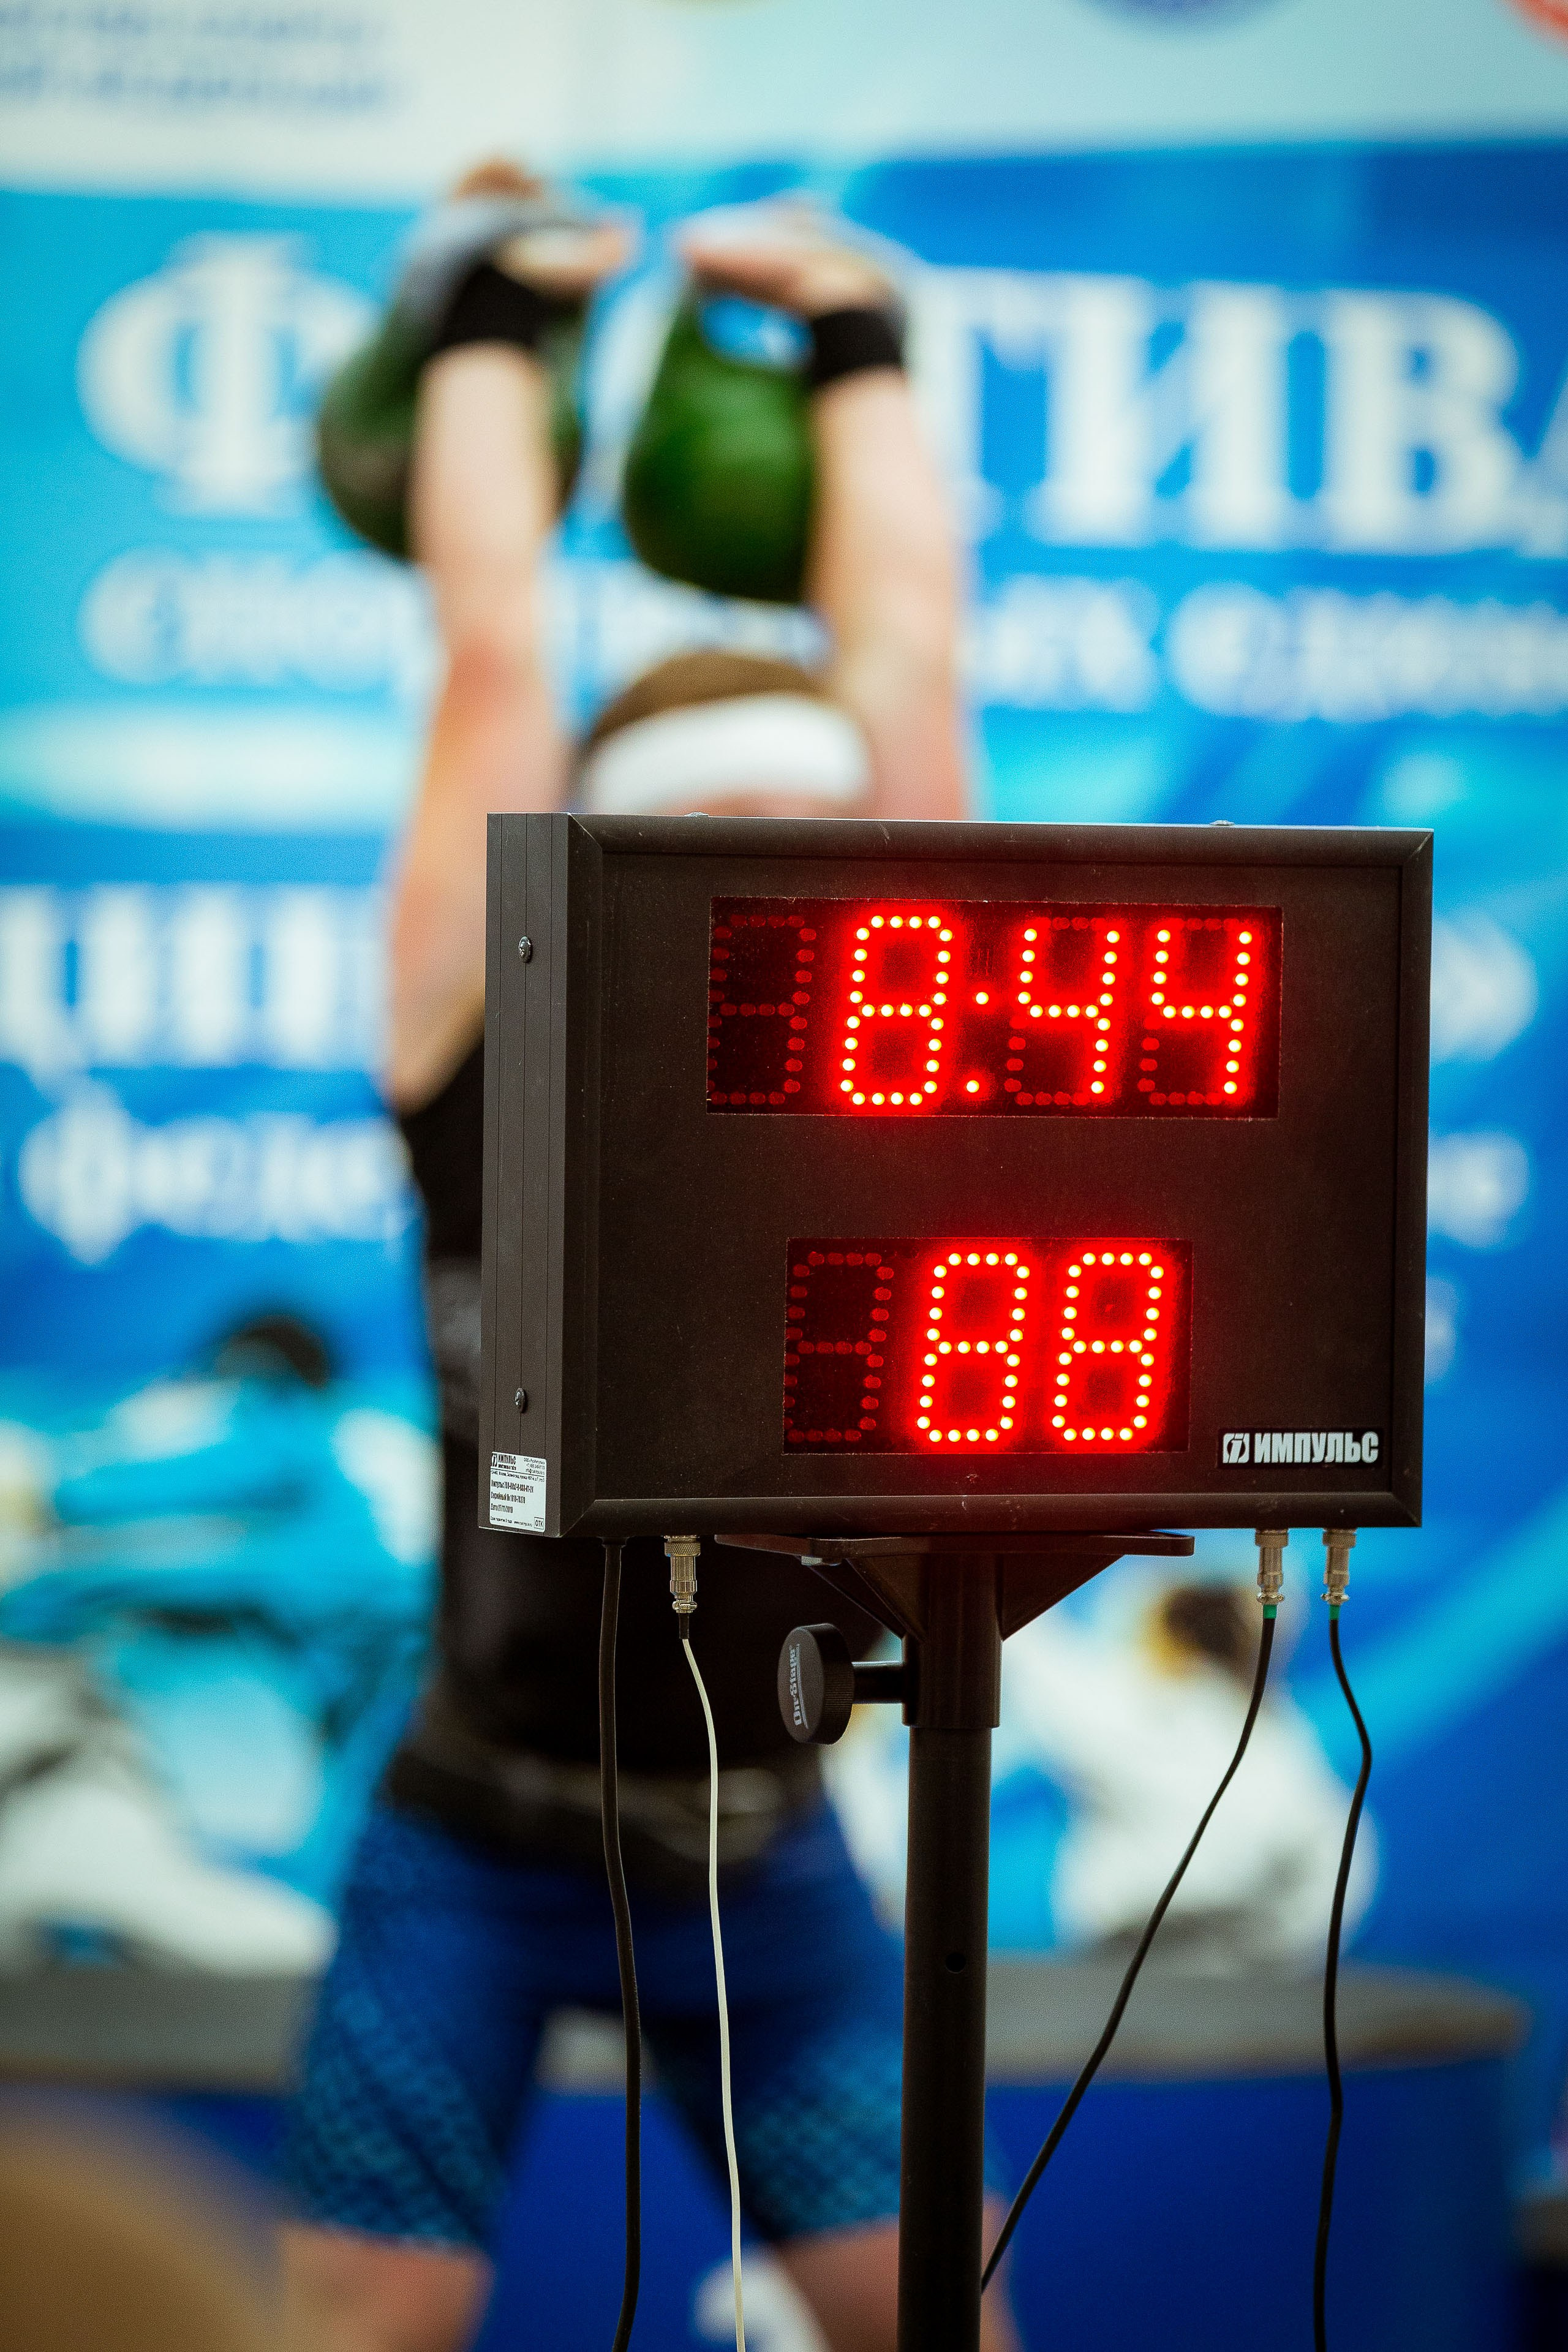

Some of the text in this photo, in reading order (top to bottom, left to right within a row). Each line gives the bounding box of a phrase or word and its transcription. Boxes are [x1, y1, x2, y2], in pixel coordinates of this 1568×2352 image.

[839, 914, 1253, 1106] 8:44
[916, 1251, 1165, 1443] 88
[1254, 1431, 1379, 1464] ИМПУЛЬС
[535, 1519, 543, 1528] ОТК
